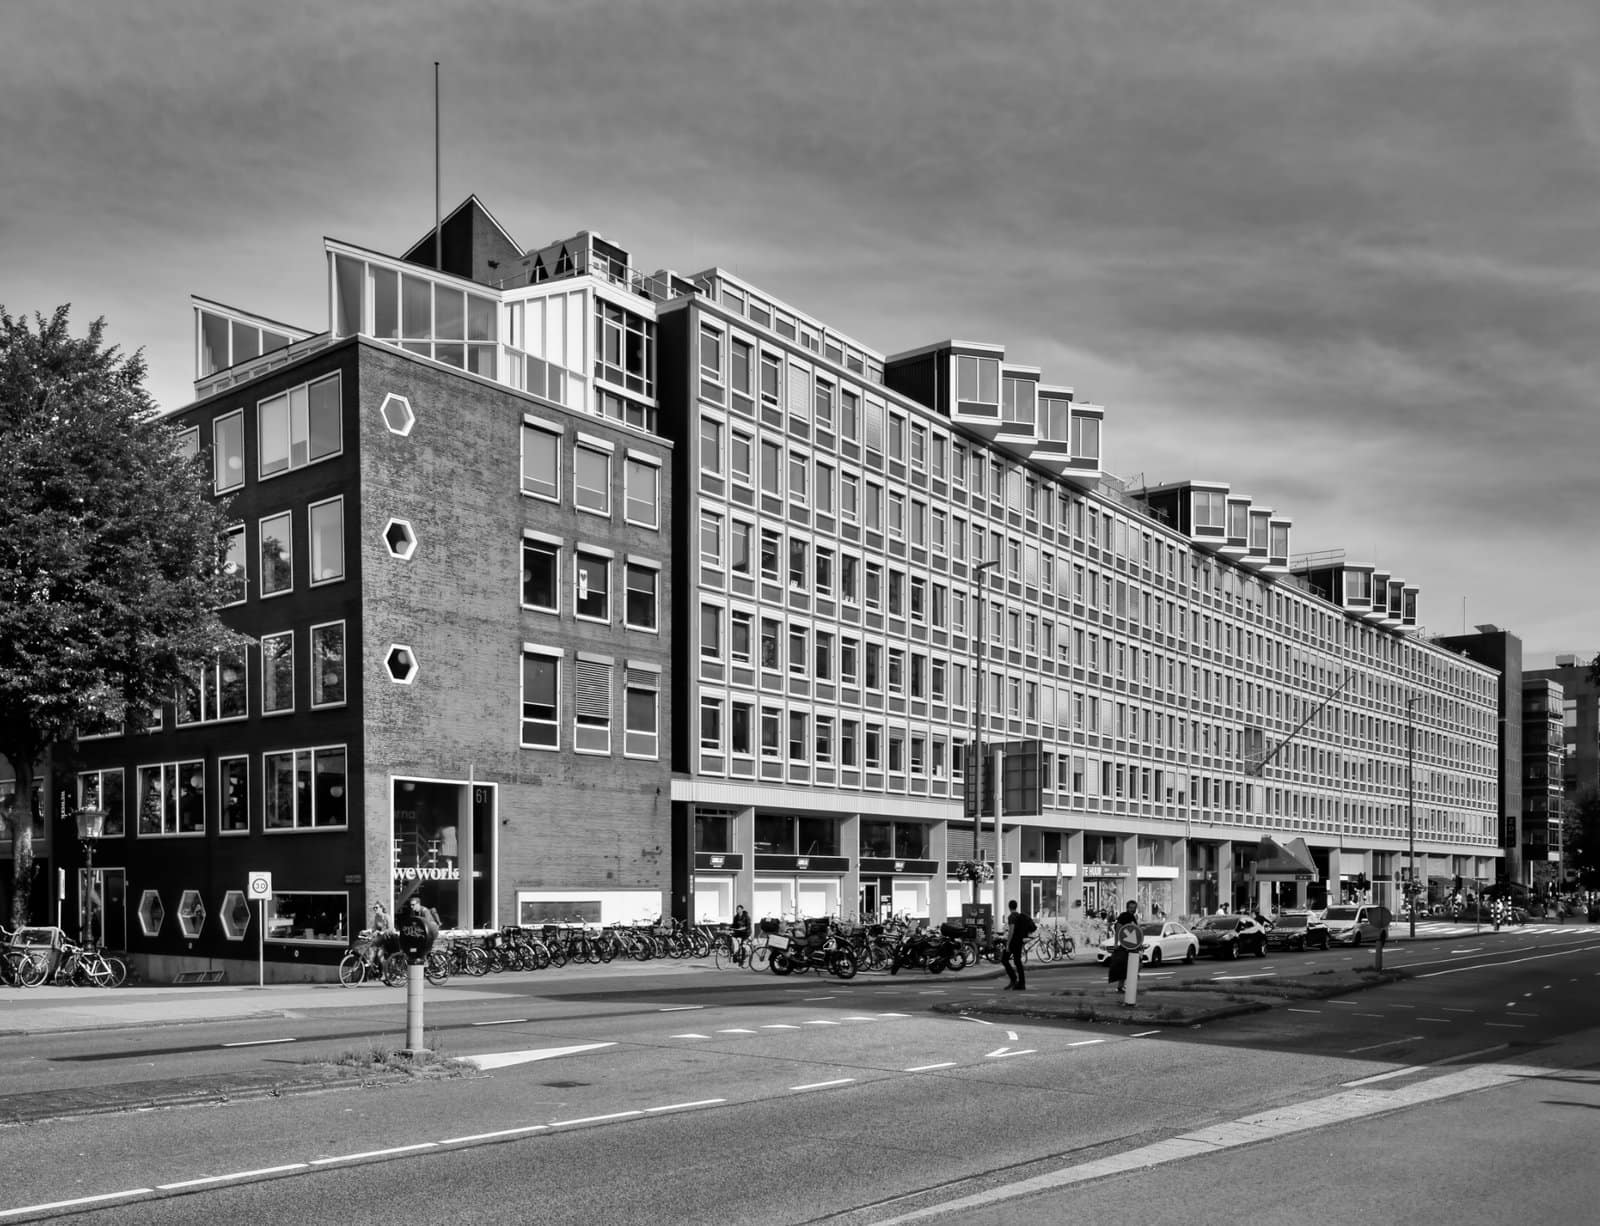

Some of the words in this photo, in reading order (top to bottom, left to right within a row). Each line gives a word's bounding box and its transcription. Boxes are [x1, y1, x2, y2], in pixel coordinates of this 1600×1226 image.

[476, 788, 488, 804] 61
[393, 858, 460, 881] wework
[255, 882, 266, 890] 30
